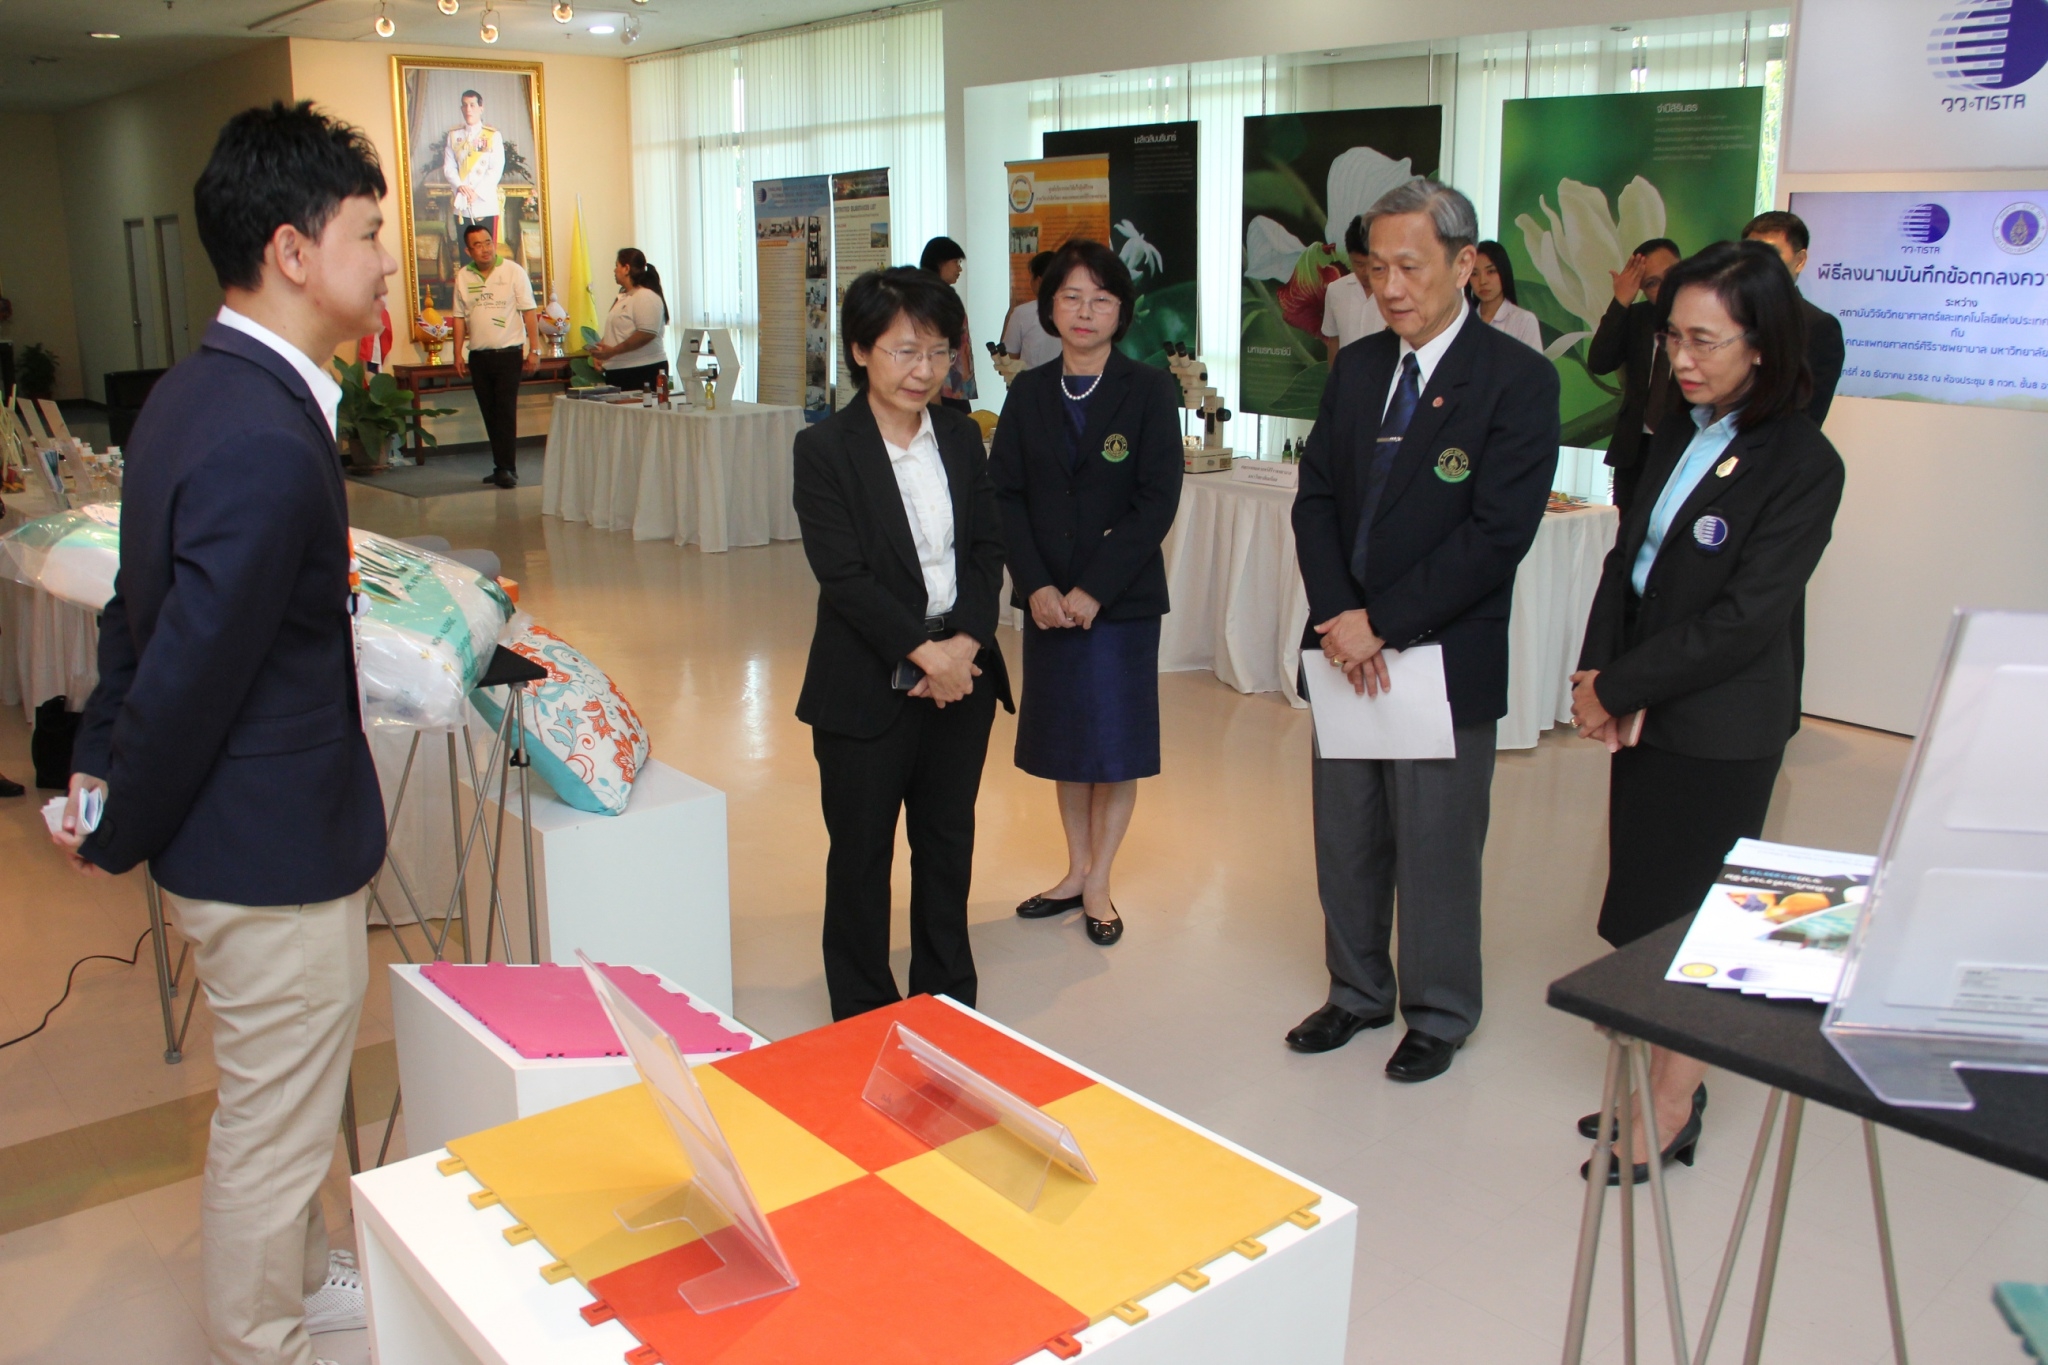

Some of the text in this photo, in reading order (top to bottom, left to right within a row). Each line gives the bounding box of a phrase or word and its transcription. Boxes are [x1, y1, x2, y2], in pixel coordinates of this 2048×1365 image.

[1817, 263, 2048, 287] พิธีลงนามบันทึกข้อตกลงคว
[1945, 297, 1978, 308] ระหว่าง
[1950, 327, 1966, 338] กับ
[1860, 369, 1871, 378] 20
[1873, 369, 1905, 380] ธันวาคม
[1907, 373, 1929, 382] 2562
